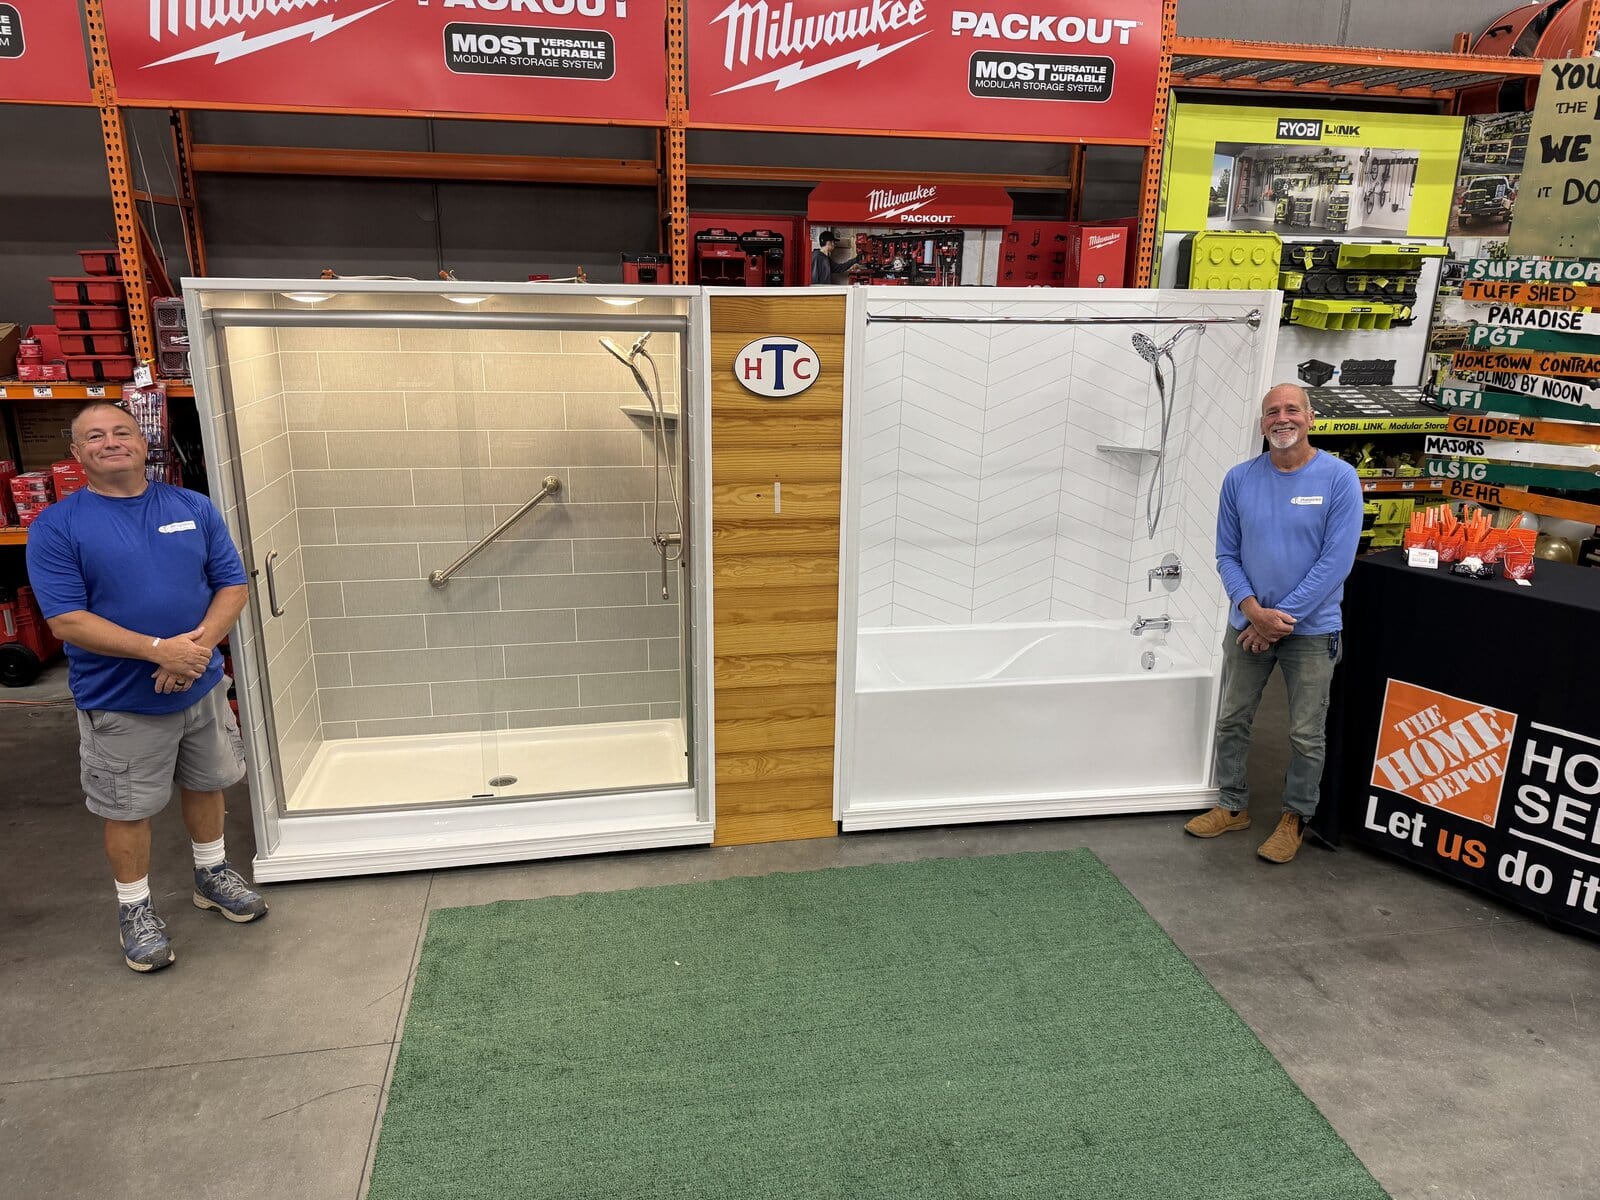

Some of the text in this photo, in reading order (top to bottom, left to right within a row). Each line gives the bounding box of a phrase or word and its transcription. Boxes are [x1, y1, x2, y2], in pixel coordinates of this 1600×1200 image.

[709, 0, 927, 70] Milwaukee
[951, 11, 1137, 45] PACKOUT
[452, 33, 606, 55] MOST VERSATILE
[541, 48, 606, 60] DURABLE
[453, 54, 603, 70] MODULAR STORAGE SYSTEM
[975, 60, 1107, 81] MOST VERSATILE
[975, 80, 1102, 93] MODULAR STORAGE SYSTEM
[1050, 73, 1106, 83] DURABLE
[1556, 101, 1588, 114] THE
[1279, 121, 1320, 137] RYOBI
[1540, 134, 1592, 163] WE
[866, 185, 937, 213] Milwaukee
[901, 215, 952, 223] PACKOUT
[1472, 259, 1600, 281] SUPERIOR
[1469, 282, 1577, 301] TUFF SHED
[1487, 306, 1584, 330] PARADISE
[1473, 326, 1525, 346] PGT
[1454, 353, 1532, 371] HOMETOWN
[1476, 371, 1583, 403] BLINDS BY NOON
[1442, 389, 1483, 409] RFI
[1333, 423, 1358, 431] RYOBI
[1363, 422, 1384, 431] LINK
[1388, 421, 1422, 430] Modular
[1453, 416, 1535, 437] GLIDDEN
[1427, 437, 1485, 456] MAJORS
[1429, 461, 1487, 480] USIG
[1450, 481, 1502, 504] BEHR
[1393, 704, 1447, 741] THE
[1376, 707, 1513, 793] HOME
[1420, 752, 1504, 805] DEPOT
[1364, 795, 1600, 914] Let us do it
